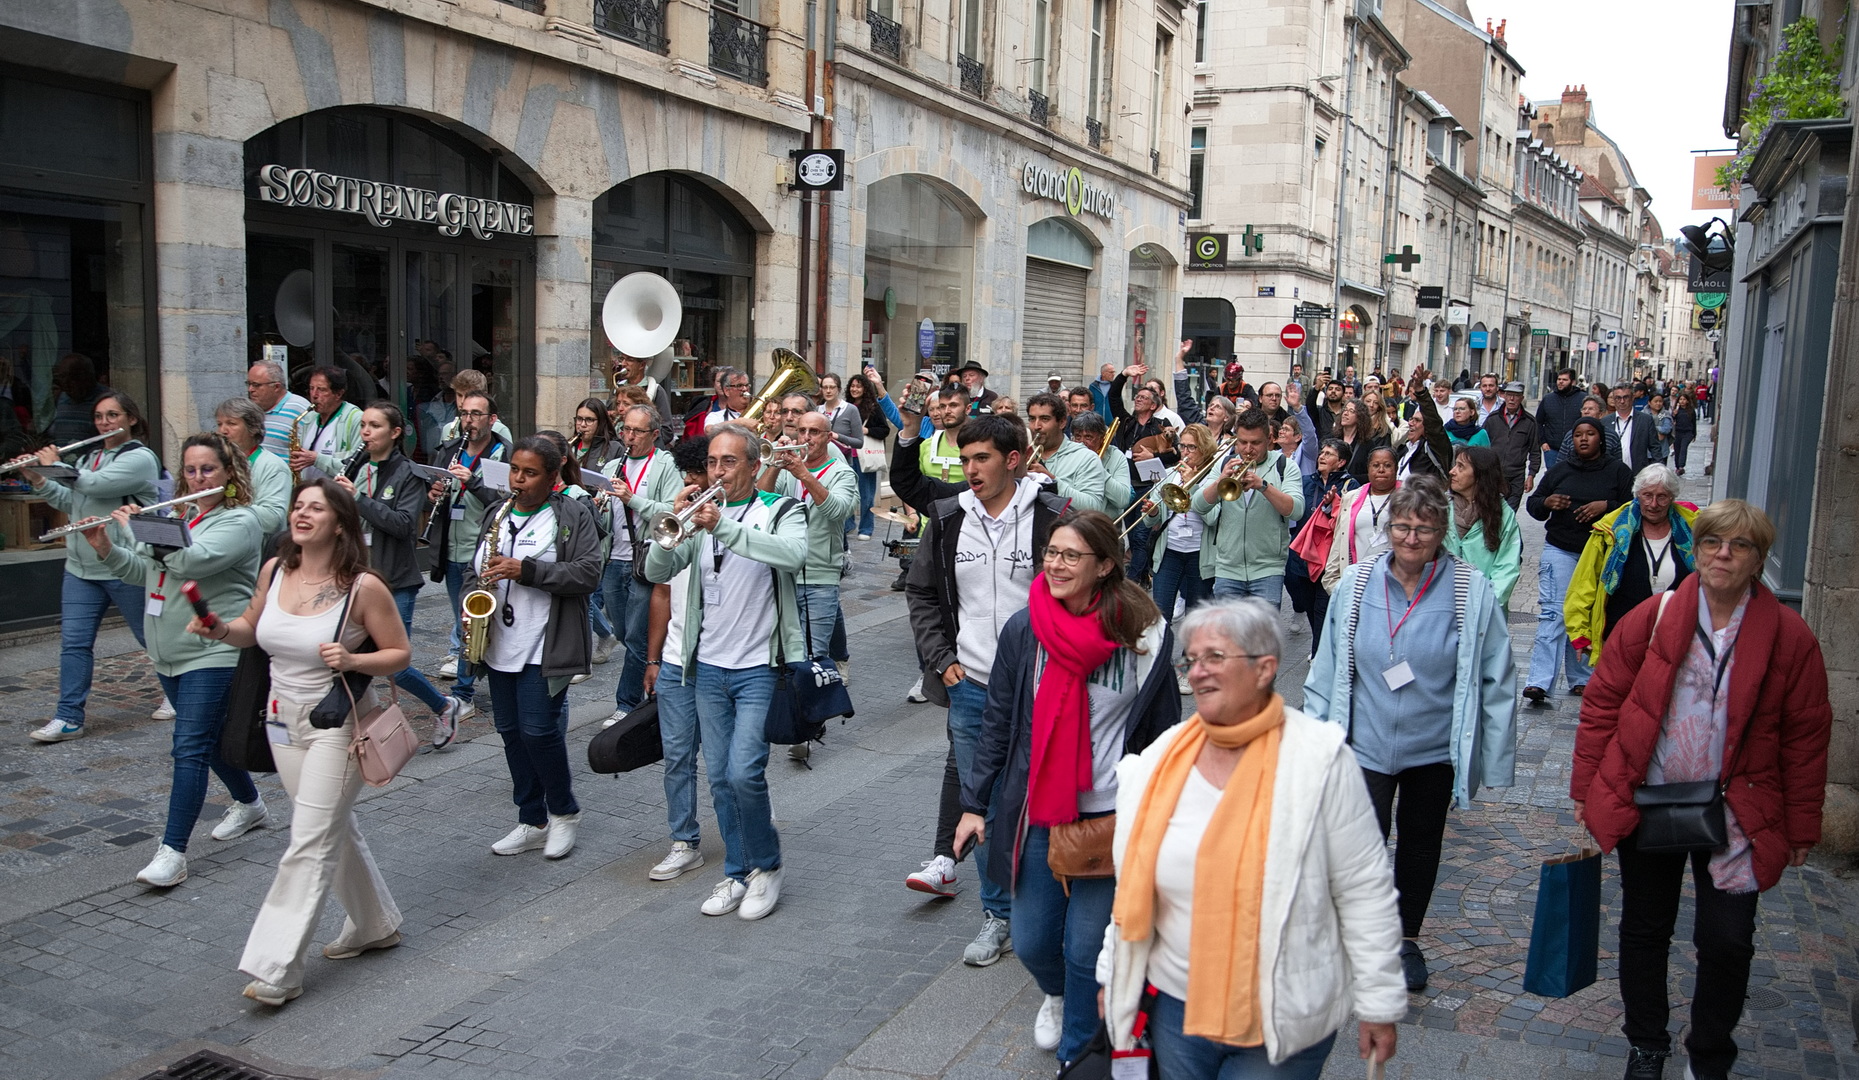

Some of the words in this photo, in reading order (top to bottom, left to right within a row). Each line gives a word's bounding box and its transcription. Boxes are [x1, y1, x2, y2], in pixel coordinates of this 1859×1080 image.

[260, 164, 438, 227] SØSTRENE
[438, 193, 533, 240] GRENE
[1201, 241, 1215, 255] G
[1692, 280, 1726, 288] CAROLL
[932, 364, 951, 375] EXPERT
